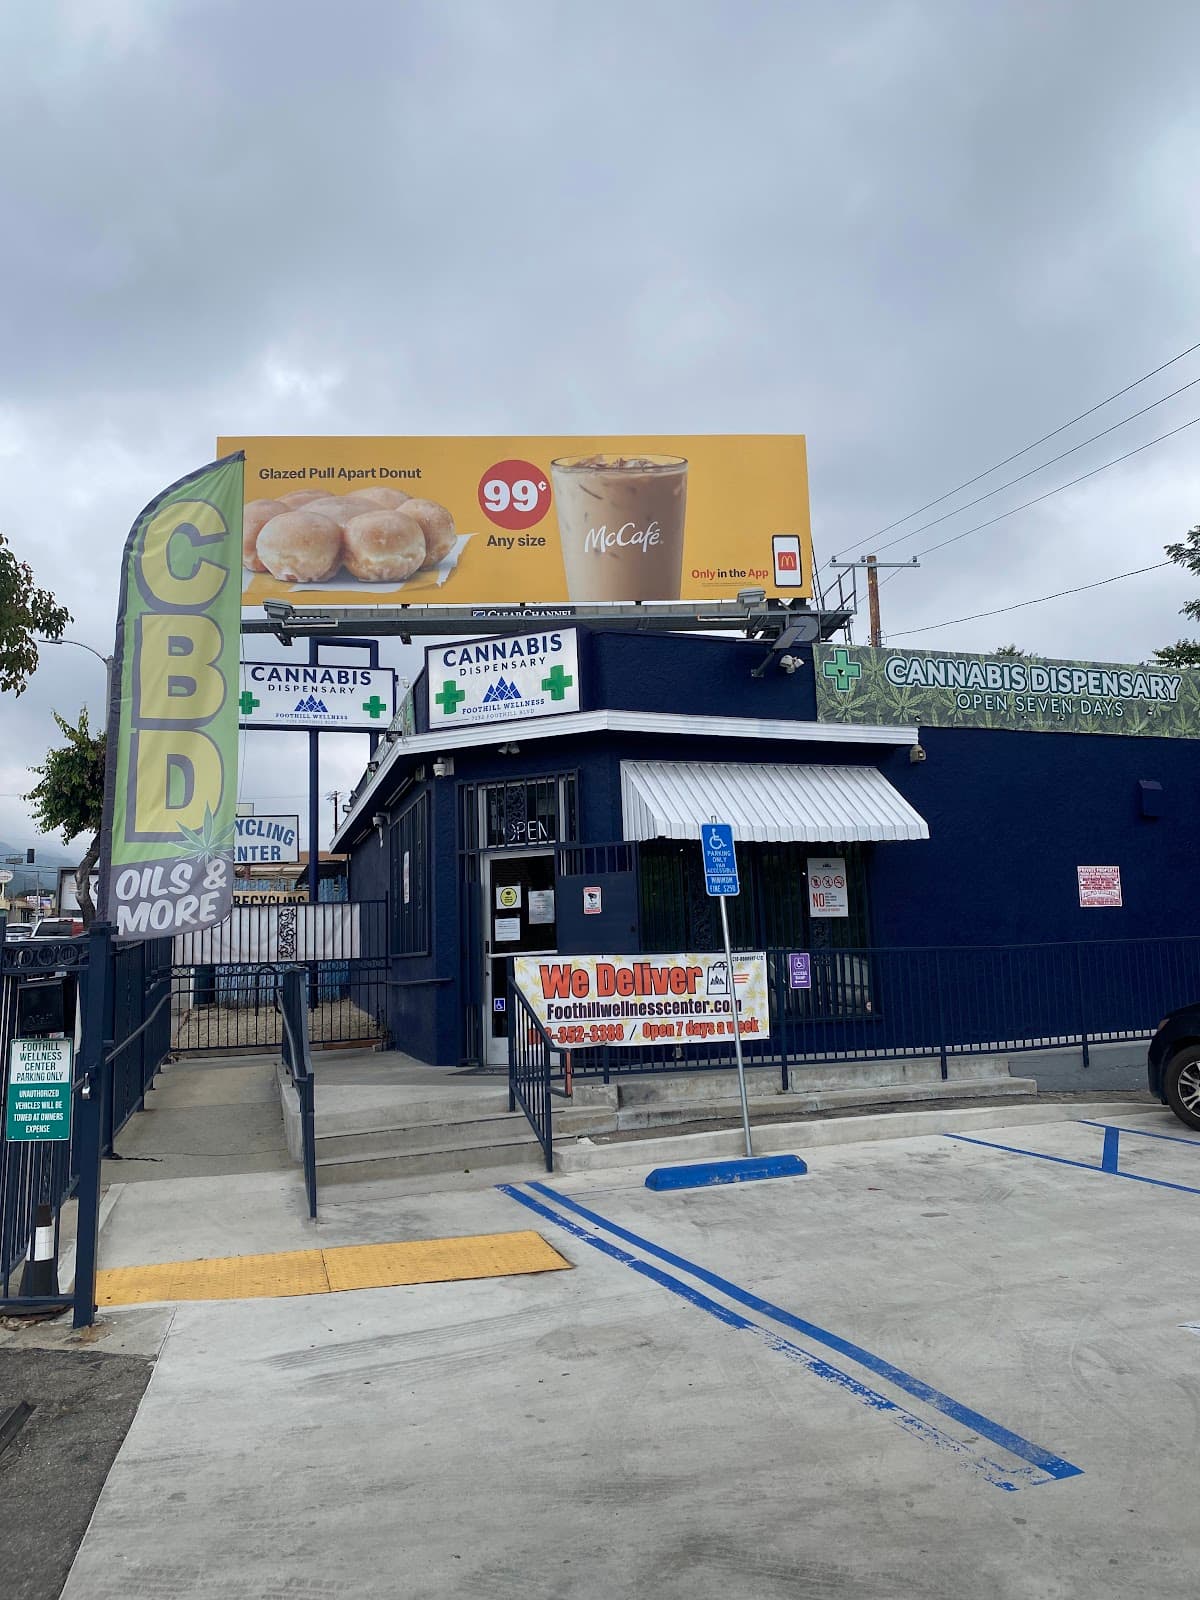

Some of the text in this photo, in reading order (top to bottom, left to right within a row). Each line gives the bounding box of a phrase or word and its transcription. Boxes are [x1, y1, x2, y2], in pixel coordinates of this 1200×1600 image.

[258, 467, 422, 481] Glazed Pull Apart Donut
[487, 534, 546, 549] Any size
[584, 521, 660, 553] McCafé
[691, 568, 769, 580] Only in the App
[443, 633, 563, 667] CANNABIS
[250, 666, 372, 686] CANNABIS
[459, 656, 547, 677] DISPENSARY
[268, 684, 355, 694] DISPENSARY
[885, 656, 1182, 702] CANNABIS DISPENSARY
[462, 698, 545, 715] FOOTHILL WELLNESS
[957, 693, 1123, 716] OPEN SEVEN DAYS
[235, 819, 295, 846] YCLING
[502, 820, 548, 841] OPEN
[116, 859, 227, 900] OILS &
[812, 893, 824, 907] NO
[117, 891, 220, 936] MORE
[539, 963, 703, 999] We Deliver
[547, 999, 742, 1020] Foothillwellnesscenter.com
[528, 1024, 625, 1045] -352-3388
[642, 1022, 675, 1040] Open
[676, 1021, 684, 1037] 7
[685, 1020, 715, 1038] days
[717, 1021, 726, 1034] a
[727, 1017, 759, 1034] week
[20, 1052, 62, 1061] WELLNESS
[22, 1042, 60, 1051] FOOTHILL
[17, 1072, 63, 1081] PARKING ONLY
[25, 1062, 56, 1071] CENTER
[26, 1125, 50, 1133] EXPENSE
